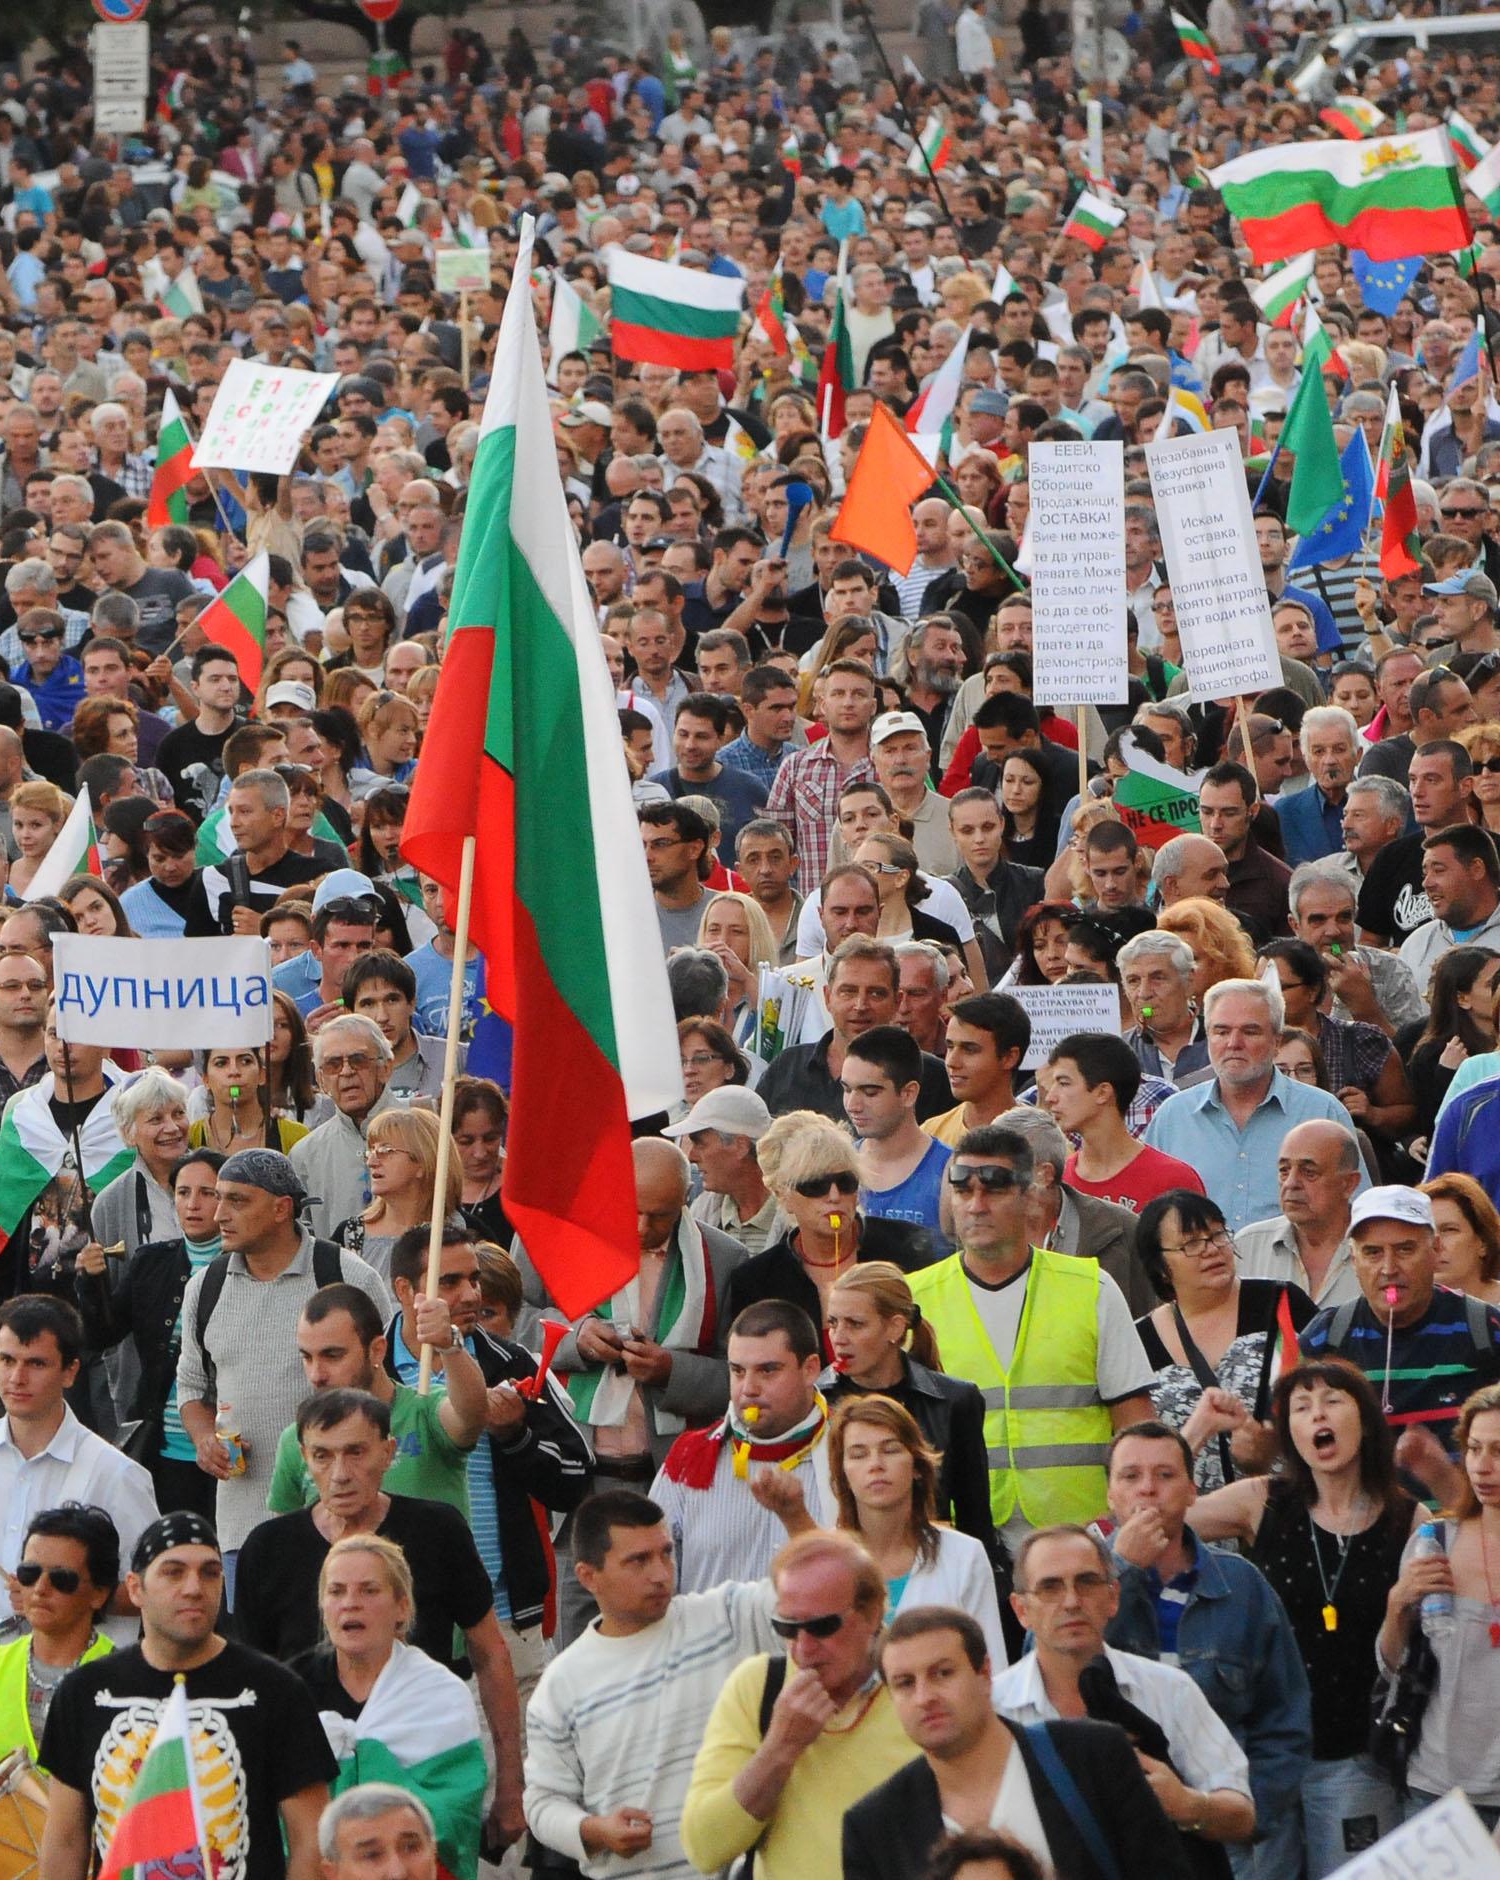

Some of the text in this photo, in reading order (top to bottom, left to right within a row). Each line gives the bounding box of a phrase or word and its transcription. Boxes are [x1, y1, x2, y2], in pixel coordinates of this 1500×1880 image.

[1150, 441, 1234, 467] Незабавна и
[1031, 462, 1101, 475] Бандитско
[1153, 460, 1227, 483] безусловна
[1031, 479, 1093, 493] Сборище
[1040, 512, 1111, 525] ОСТАВКА!
[1181, 513, 1224, 529] Искам
[1060, 532, 1077, 542] не
[1051, 551, 1068, 563] да
[1188, 546, 1236, 564] защото
[1052, 586, 1086, 596] само
[1173, 572, 1248, 595] политиката
[1052, 607, 1070, 618] да
[1073, 606, 1089, 616] се
[1176, 596, 1213, 613] която
[1204, 609, 1237, 624] води
[1239, 604, 1267, 618] към
[1075, 640, 1085, 650] и
[1087, 639, 1104, 651] да
[1184, 638, 1255, 661] поредната
[1187, 652, 1268, 677] национална
[1149, 805, 1167, 824] СЕ
[1168, 797, 1200, 821] ПРО
[59, 972, 269, 1018] дупница
[1012, 989, 1051, 999] АРОДЪТ
[1028, 1008, 1094, 1017] АВИТЕЛСТВОТО
